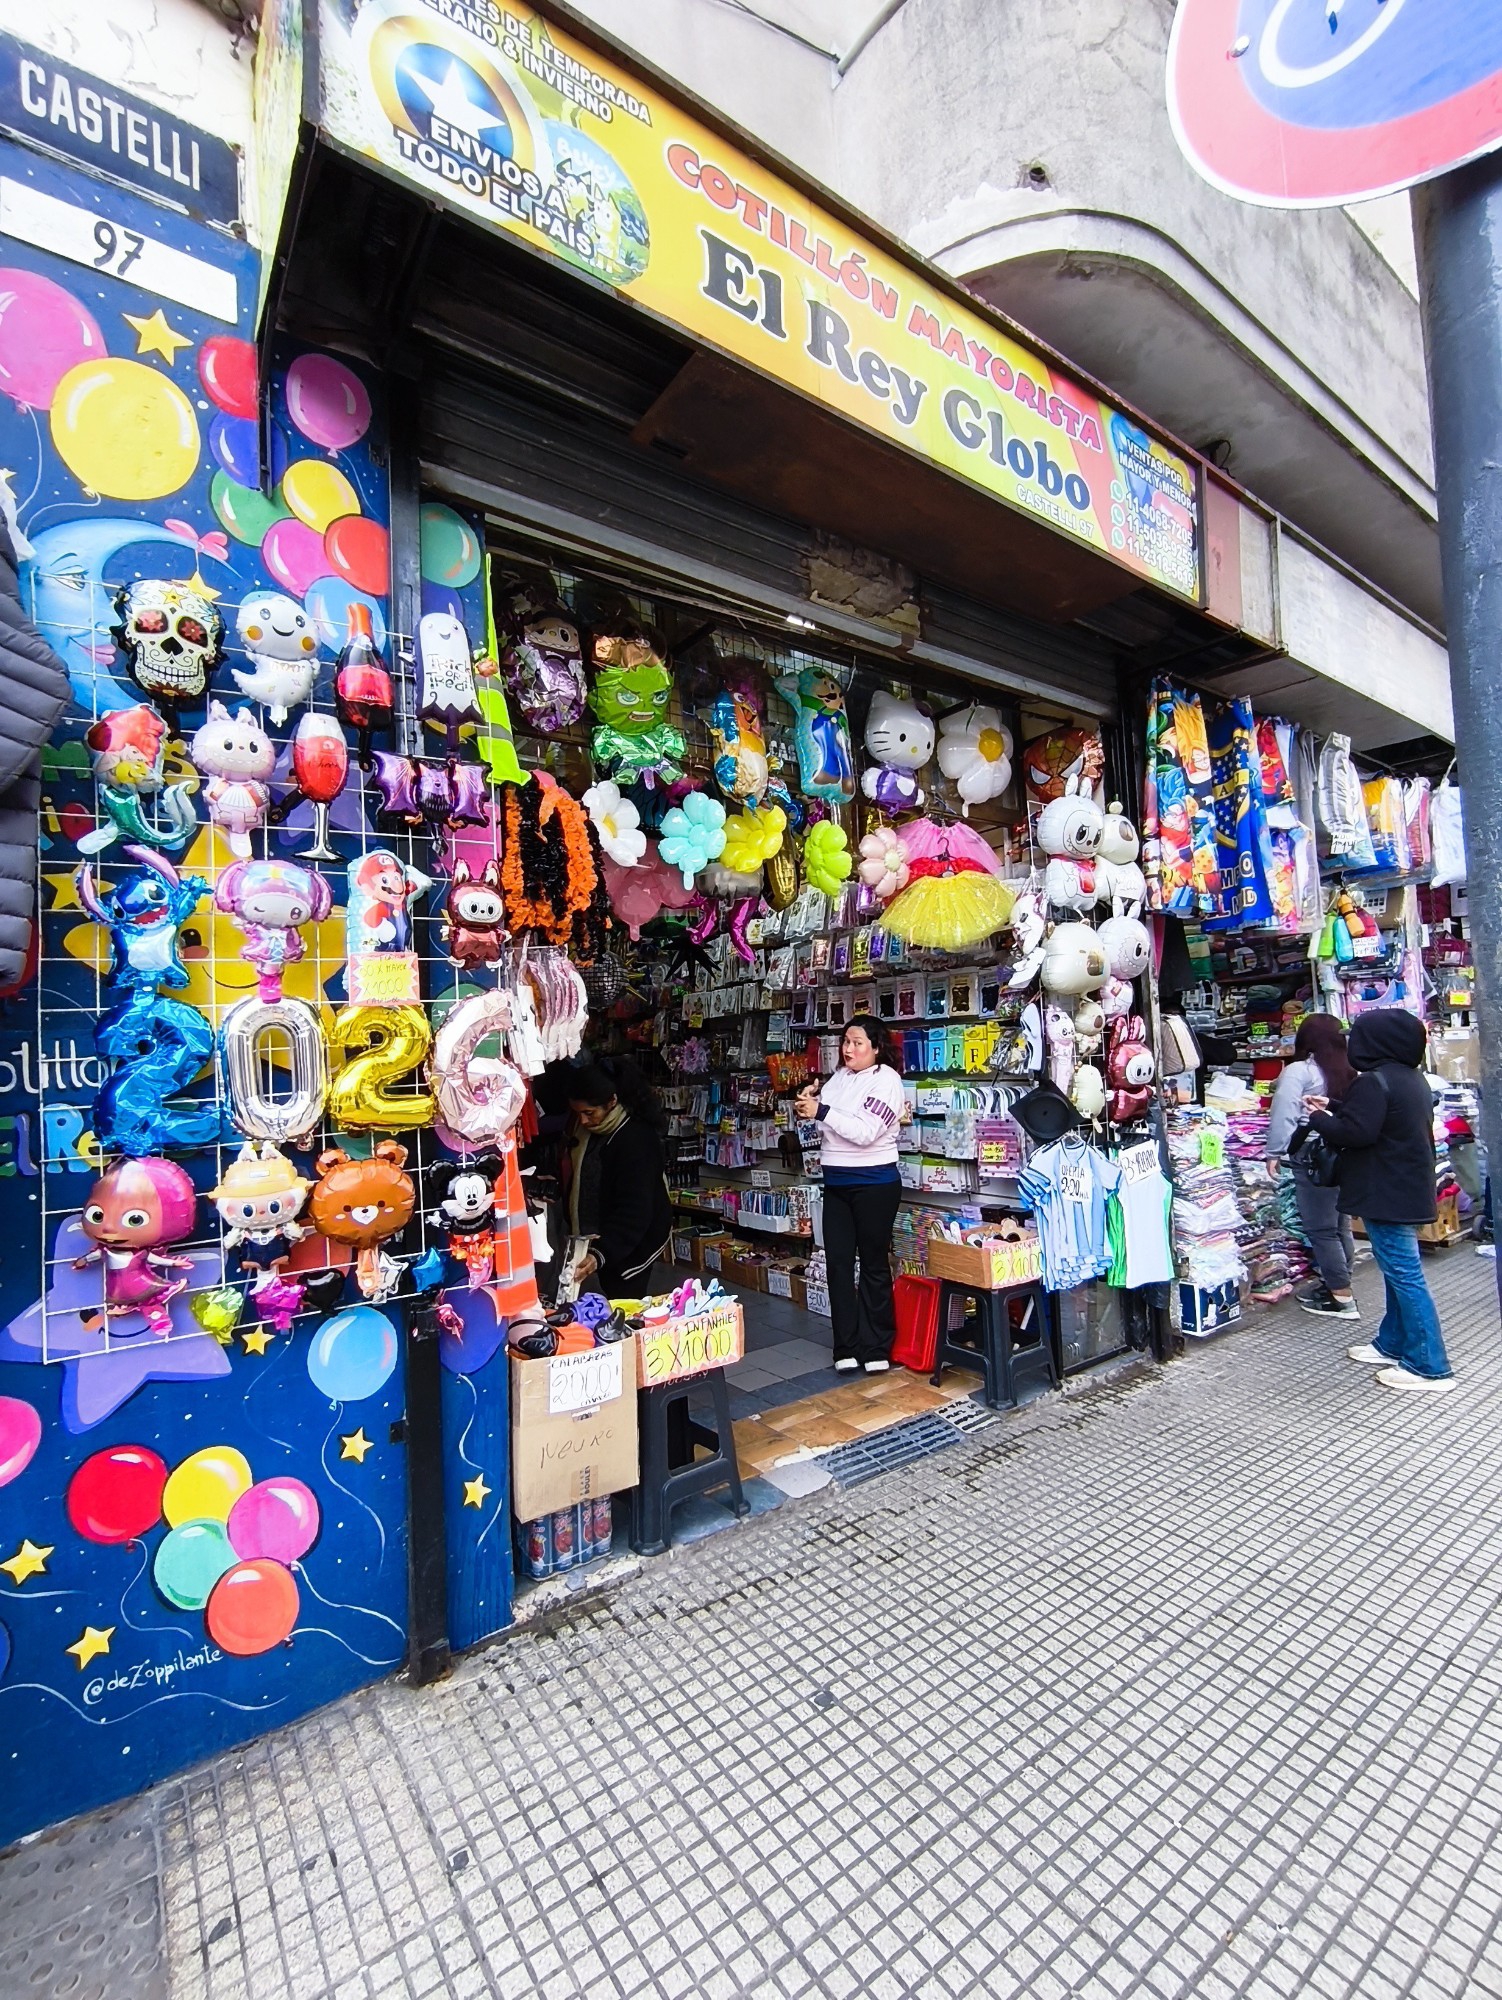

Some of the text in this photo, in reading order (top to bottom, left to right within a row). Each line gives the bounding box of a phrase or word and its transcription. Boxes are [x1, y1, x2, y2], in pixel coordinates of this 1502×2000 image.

[502, 38, 520, 63] &
[522, 50, 614, 123] INVIERNO
[503, 18, 533, 49] DE
[539, 39, 652, 127] TEMPORADA
[19, 58, 201, 191] CASTELLI
[396, 130, 595, 260] TODO EL PAÍS
[430, 116, 569, 222] ENVIOS A
[93, 221, 145, 276] 97
[667, 143, 1103, 453] COTILLÓN MAYORISTA
[701, 228, 1092, 512] El Rey Globo
[1118, 452, 1153, 486] MAYOR
[1162, 478, 1193, 512] MENOR
[1127, 438, 1184, 490] VENTAS POR
[1017, 482, 1095, 539] CASTELLI 97
[1126, 491, 1194, 547] 11-4068-7205
[863, 1096, 897, 1129] PUM
[551, 1349, 613, 1370] CALABAZAS
